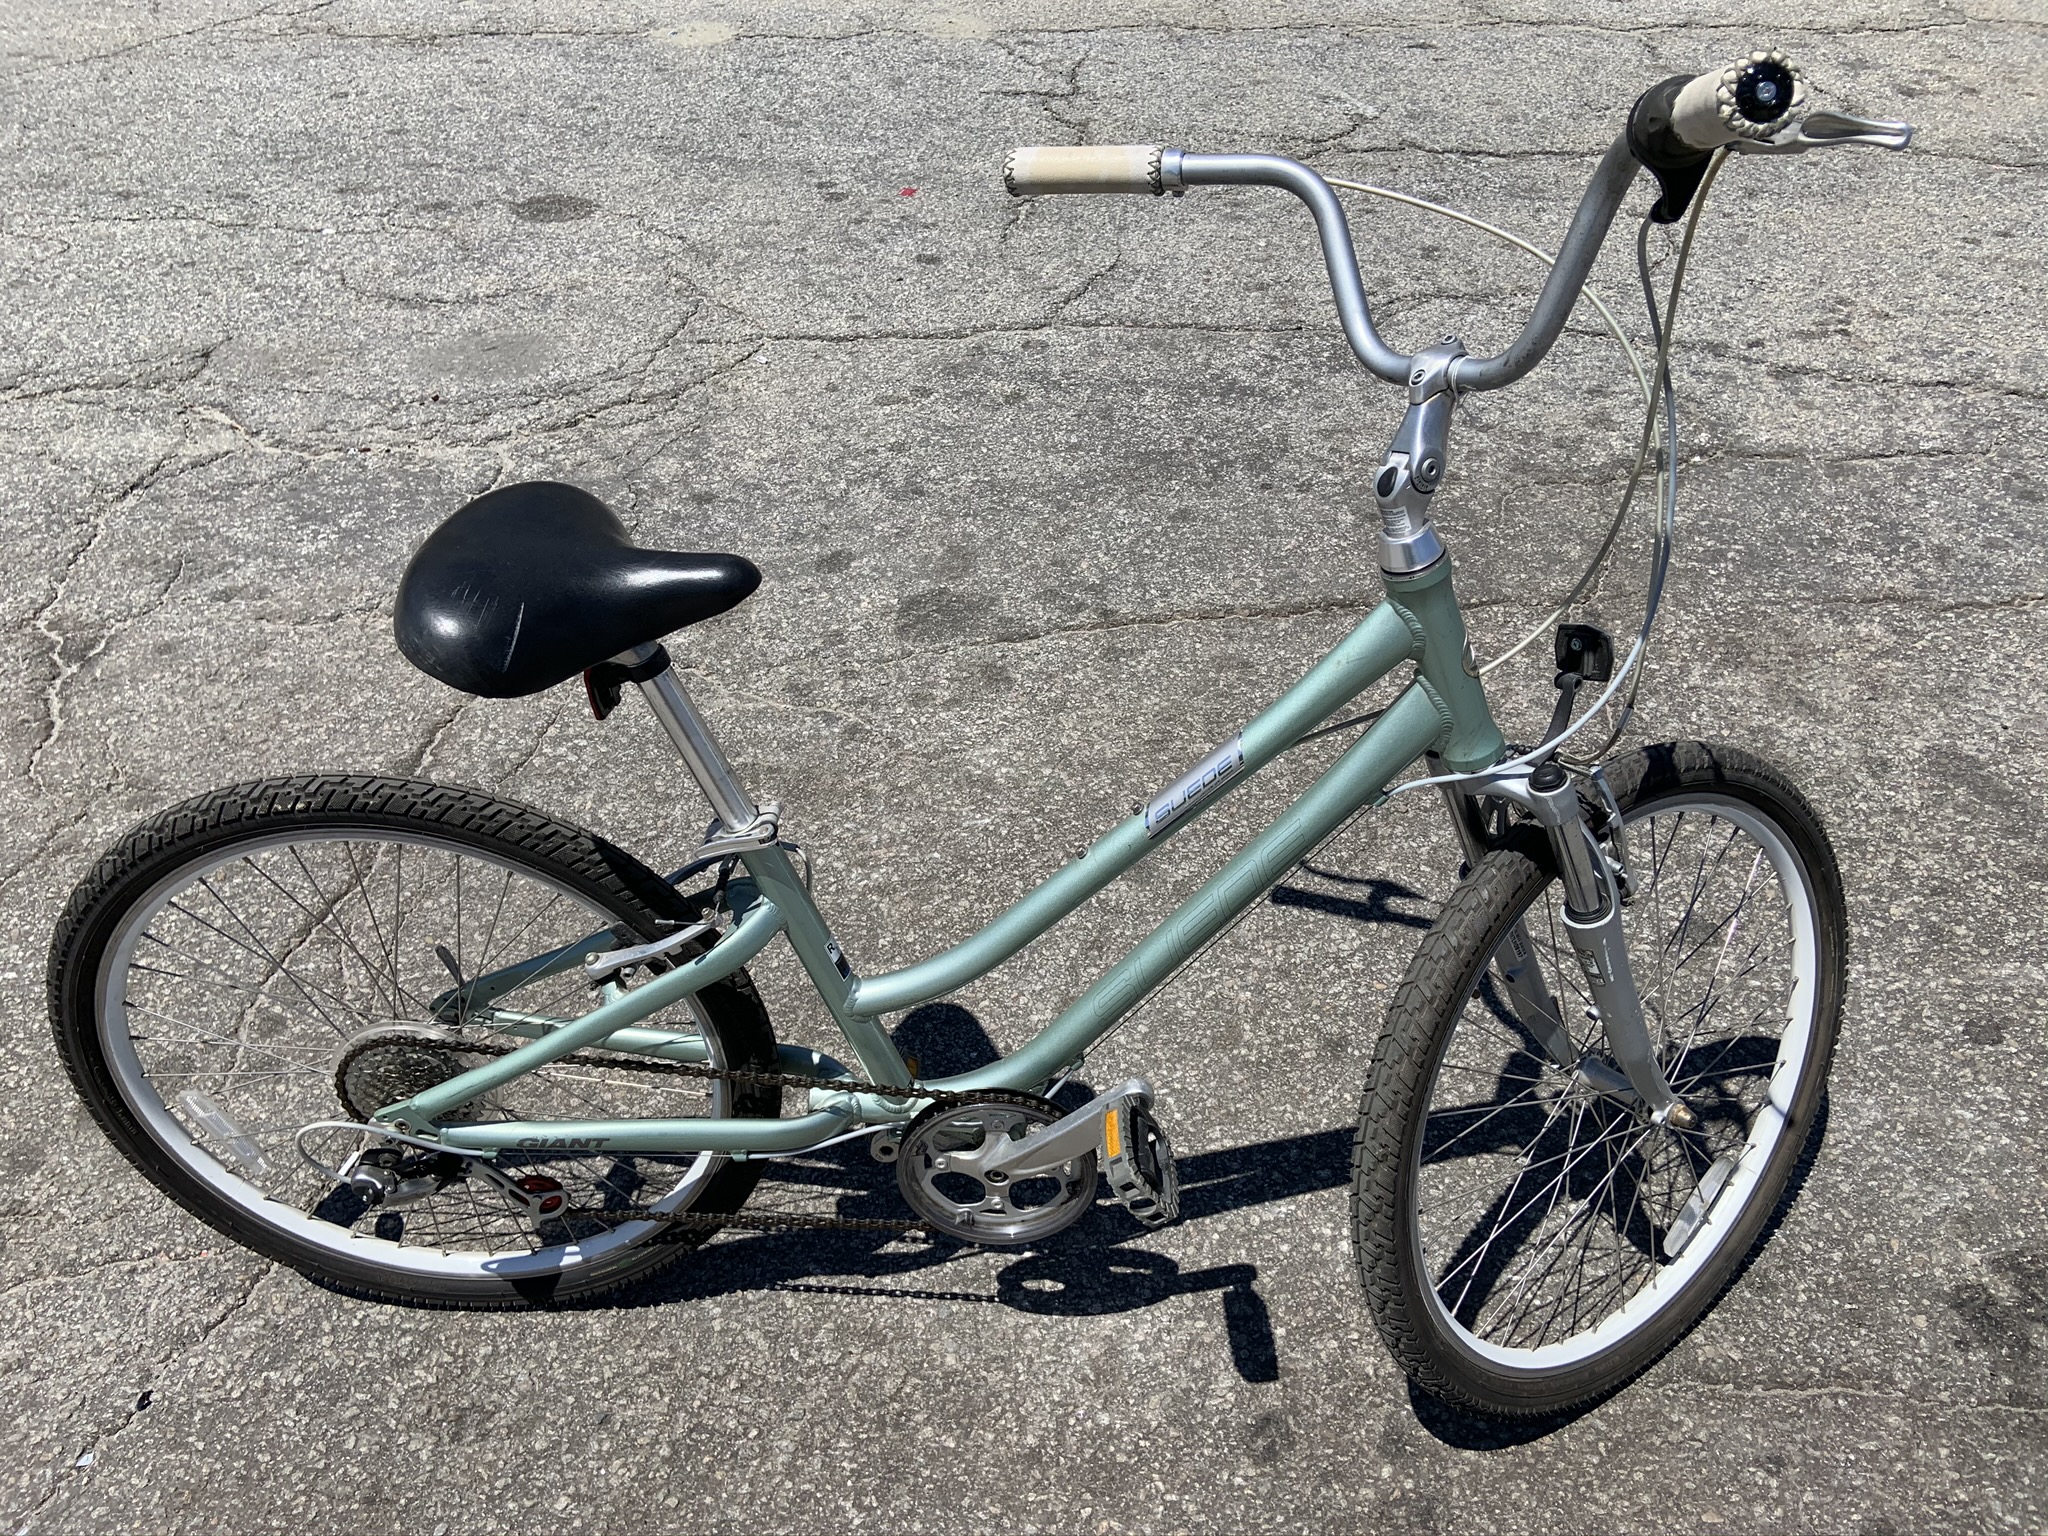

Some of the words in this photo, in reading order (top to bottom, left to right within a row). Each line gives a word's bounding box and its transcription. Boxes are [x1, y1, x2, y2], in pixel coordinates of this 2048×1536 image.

[1154, 754, 1233, 824] SUEDE
[1093, 818, 1309, 1027] SUEDE
[517, 1137, 610, 1148] GIANT
